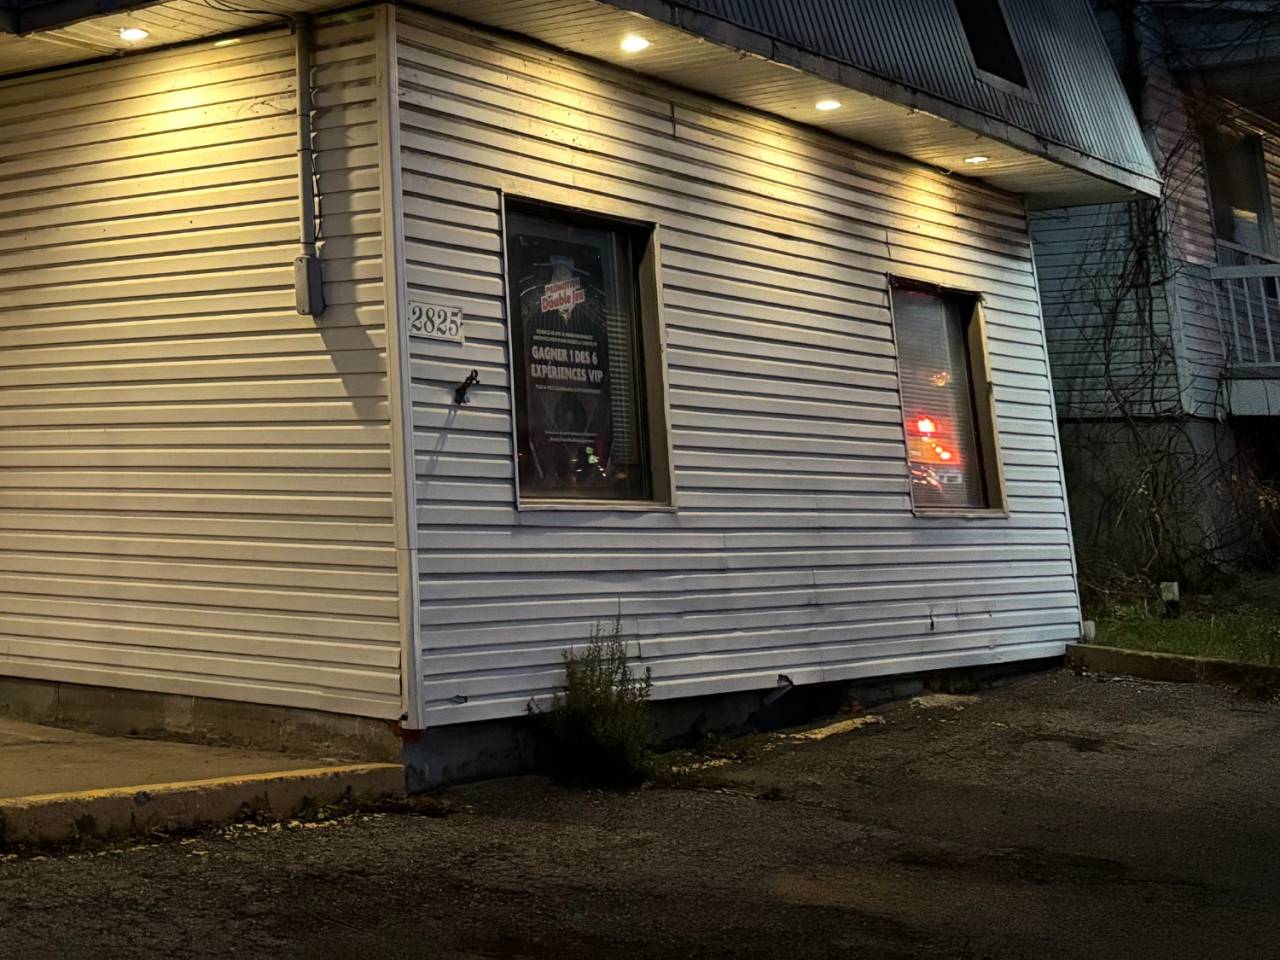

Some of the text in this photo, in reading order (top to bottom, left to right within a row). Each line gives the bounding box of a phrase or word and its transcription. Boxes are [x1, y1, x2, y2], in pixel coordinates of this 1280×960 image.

[411, 306, 459, 336] 2825
[531, 345, 598, 365] GAGNER 1 DES 6
[531, 360, 603, 383] EXPÉRIENCES VIP
